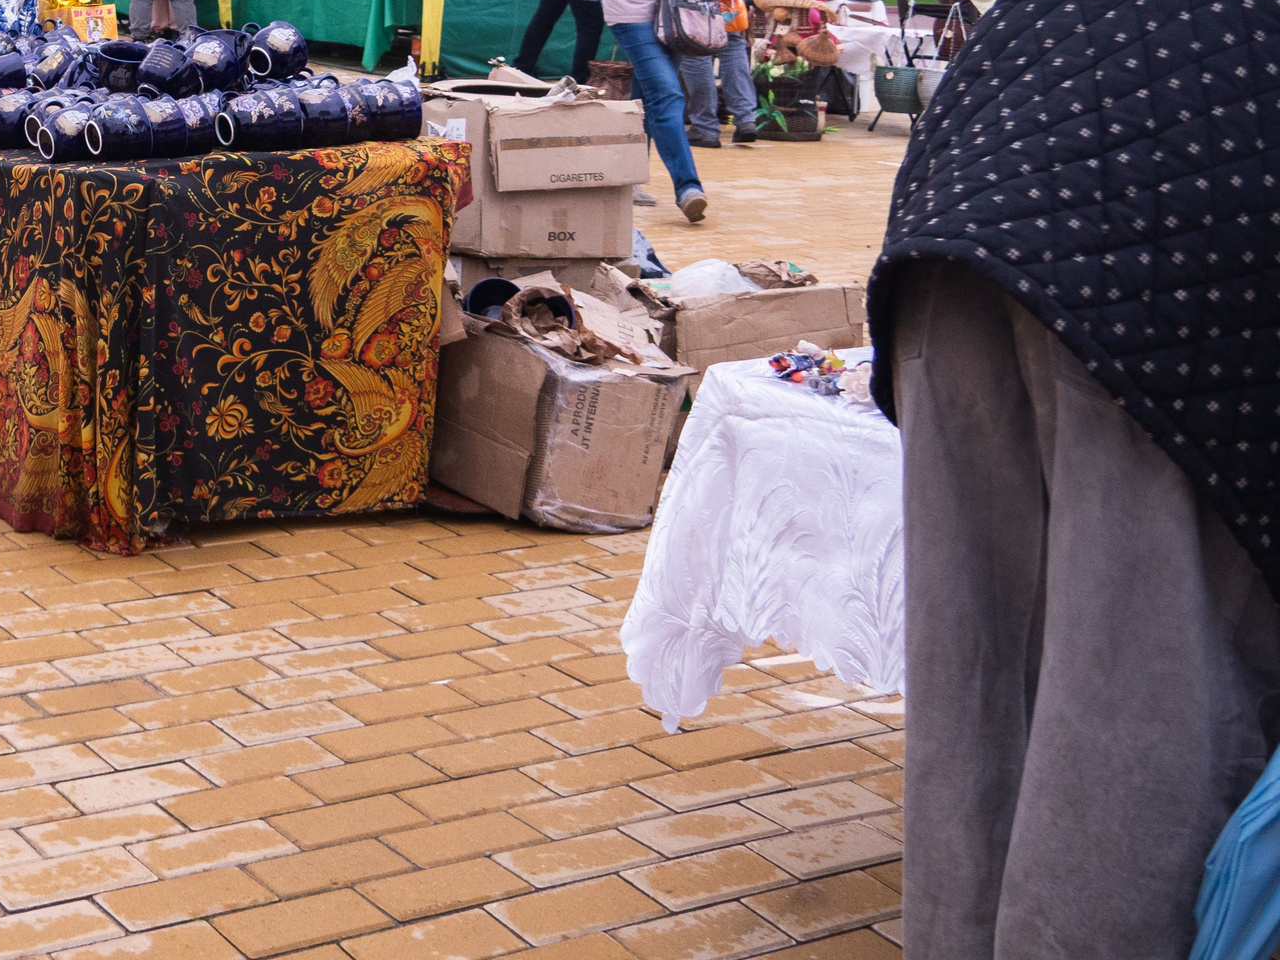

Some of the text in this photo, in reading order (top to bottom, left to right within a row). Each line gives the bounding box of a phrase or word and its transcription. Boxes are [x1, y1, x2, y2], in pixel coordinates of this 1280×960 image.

[549, 172, 605, 184] CIGARETTES
[547, 231, 576, 241] BOX
[570, 385, 588, 437] A PRODU
[581, 435, 591, 450] JT
